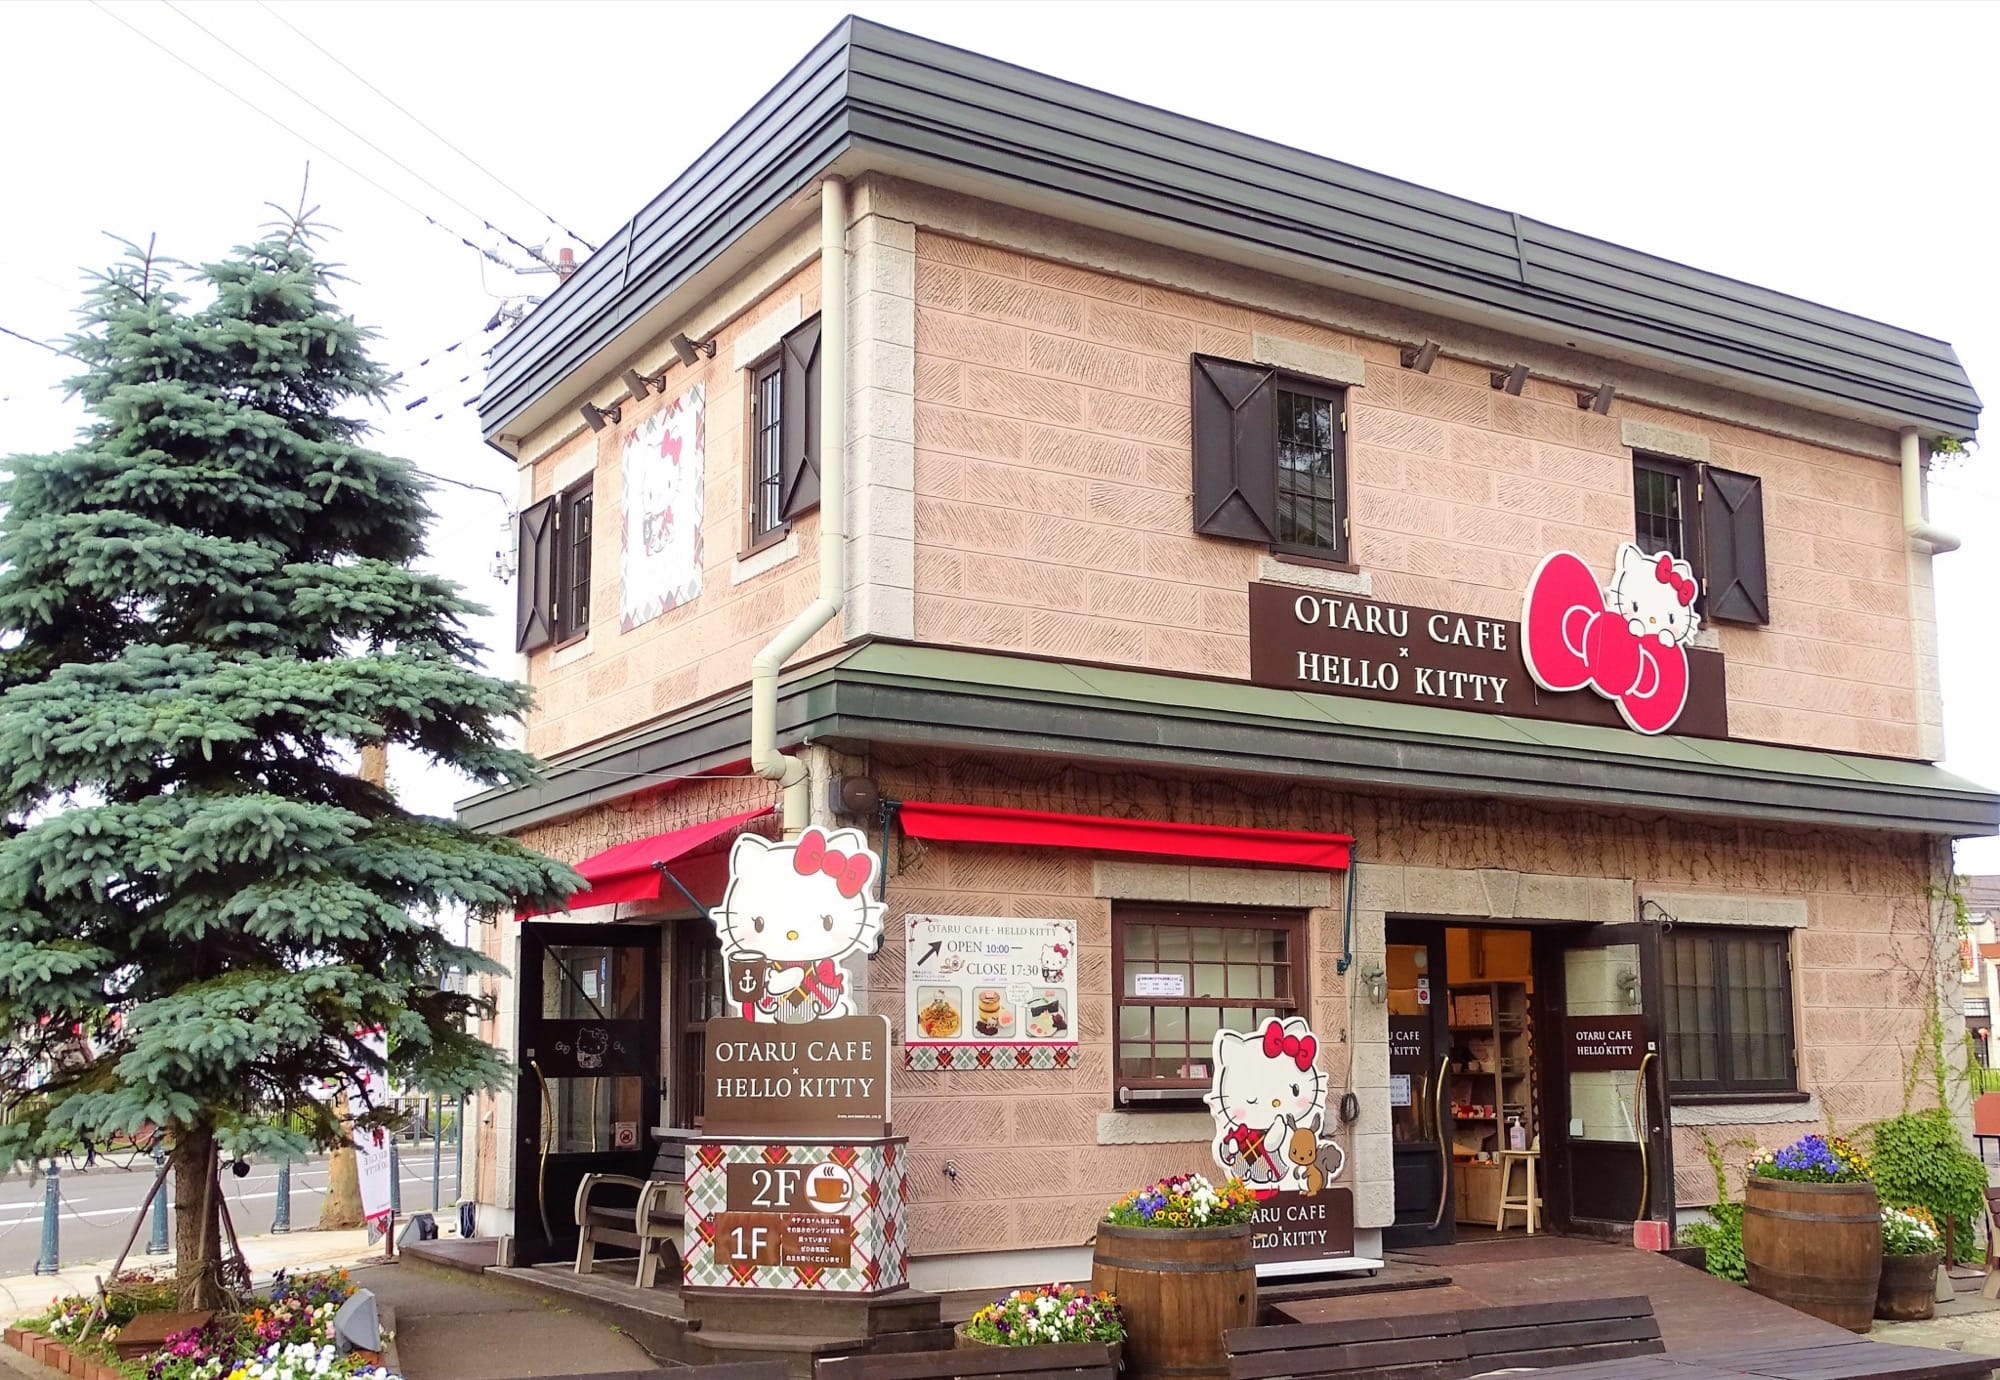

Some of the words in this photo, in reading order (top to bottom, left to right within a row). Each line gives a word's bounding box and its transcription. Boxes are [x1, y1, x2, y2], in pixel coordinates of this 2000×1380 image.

[1293, 595, 1410, 639] OTARU
[1427, 615, 1507, 652] CAFE
[1296, 651, 1400, 692] HELLO
[1415, 667, 1508, 705] KITTY
[927, 925, 961, 933] OTARU
[964, 926, 989, 935] CAFE
[997, 927, 1027, 936] HELLO
[1029, 928, 1057, 937] KITTY
[947, 940, 982, 953] OPEN
[986, 944, 1010, 954] 10:00
[967, 963, 1007, 975] CLOSE
[1011, 964, 1039, 976] 17:30
[1396, 1031, 1420, 1041] CAFE
[1575, 1030, 1606, 1041] OTARU
[1608, 1030, 1633, 1041] CAFE
[715, 1042, 797, 1062] OTARU
[807, 1041, 873, 1062] CAFE
[1394, 1046, 1421, 1056] KITTY
[1577, 1045, 1605, 1056] HELLO
[1606, 1045, 1634, 1056] KITTY
[716, 1078, 792, 1098] HELLO
[799, 1078, 875, 1097] KITTY
[751, 1169, 801, 1208] 2F
[1287, 1205, 1325, 1221] CAFE
[730, 1227, 768, 1260] 1F
[1283, 1230, 1327, 1247] KITTY
